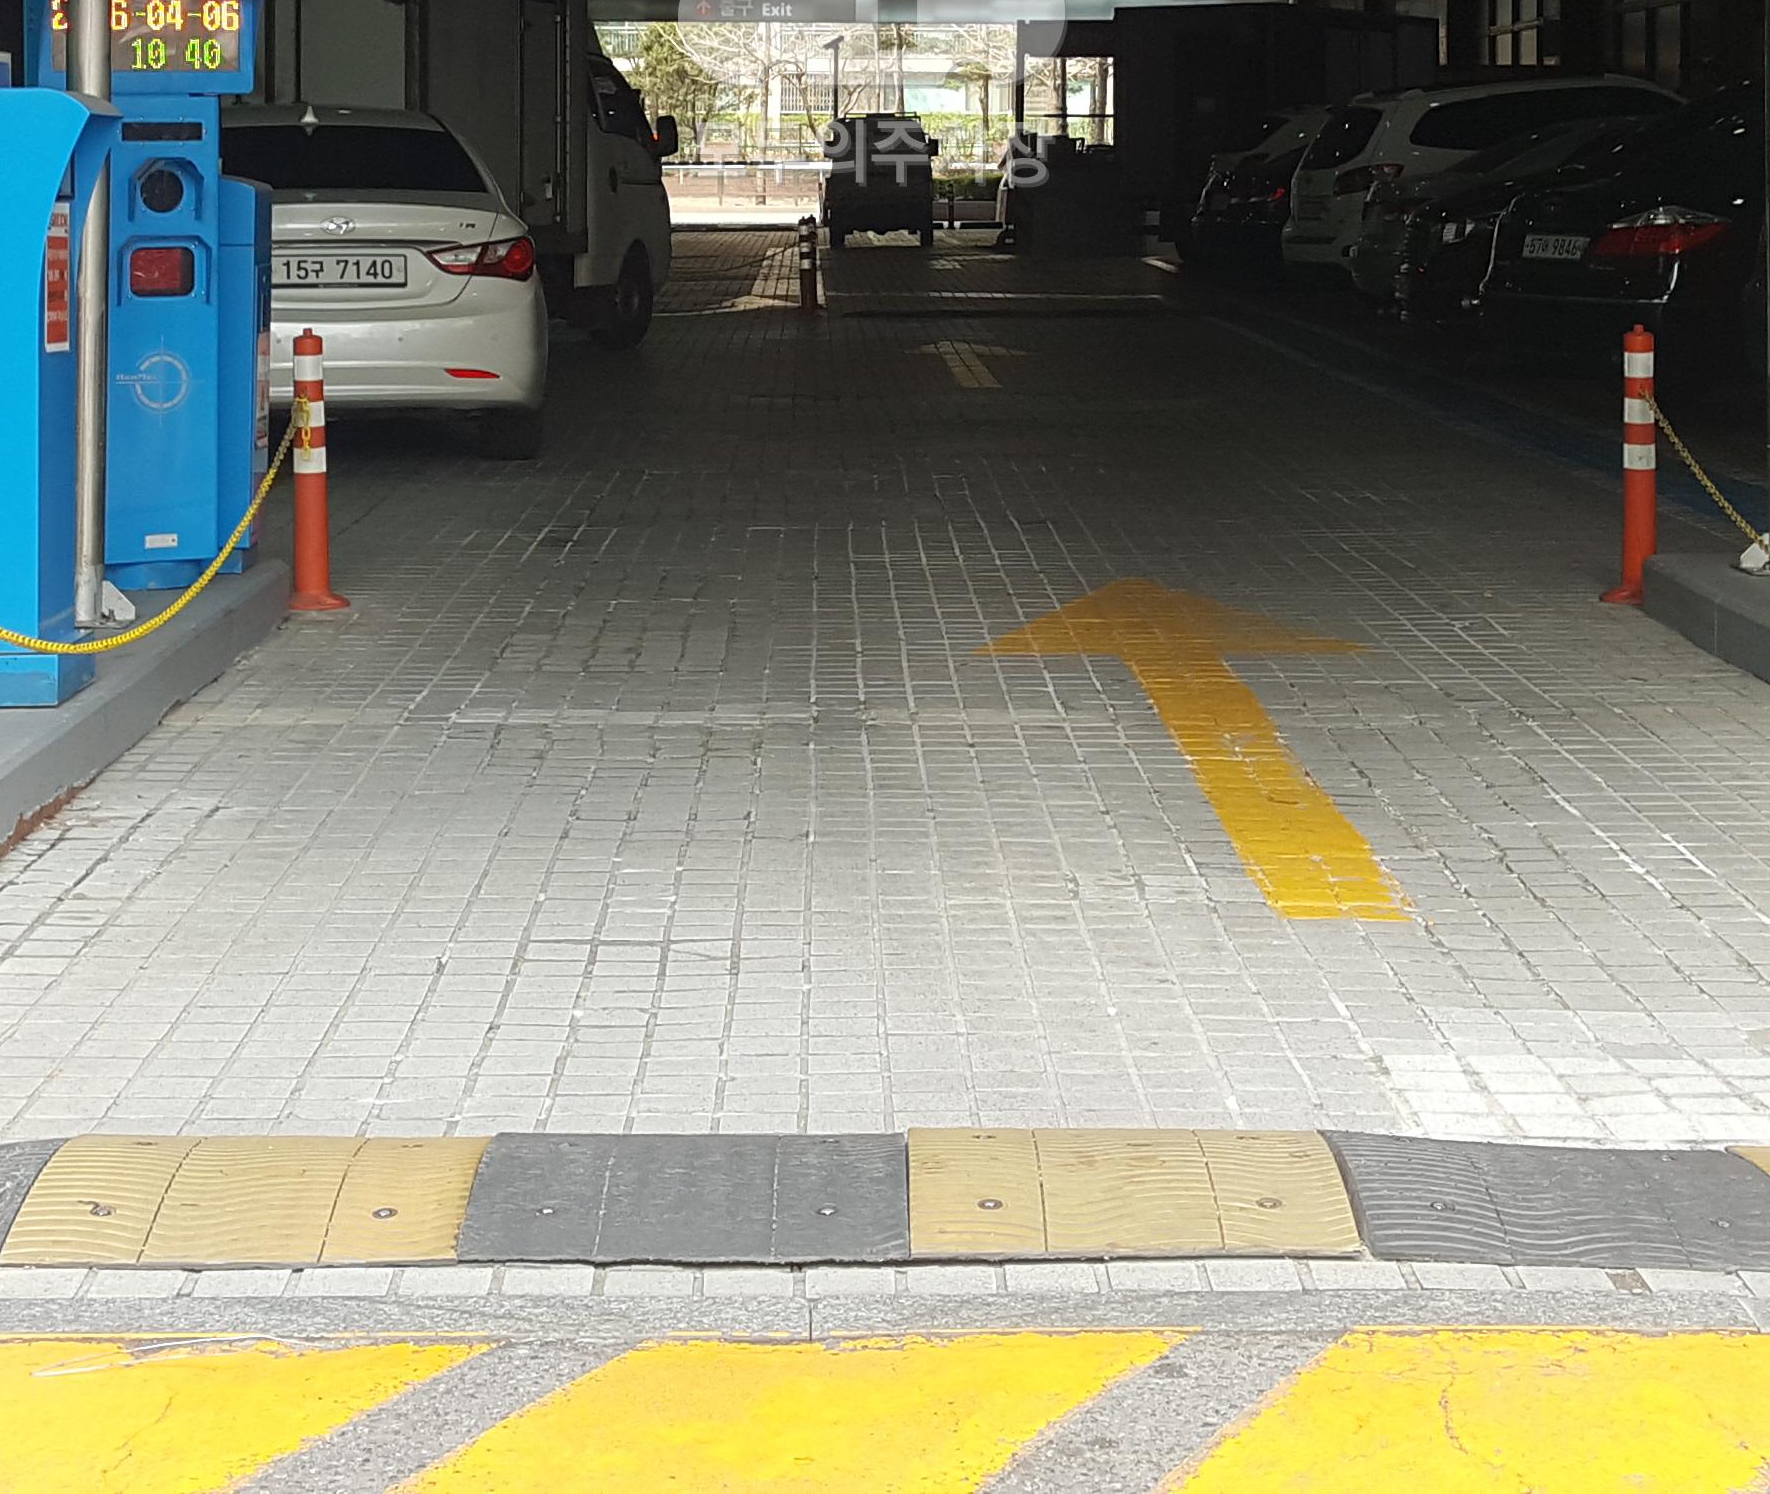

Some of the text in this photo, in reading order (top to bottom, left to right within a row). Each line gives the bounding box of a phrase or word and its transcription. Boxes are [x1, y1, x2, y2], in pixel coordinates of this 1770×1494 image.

[762, 3, 792, 18] Exit
[281, 259, 394, 281] 15구 7140
